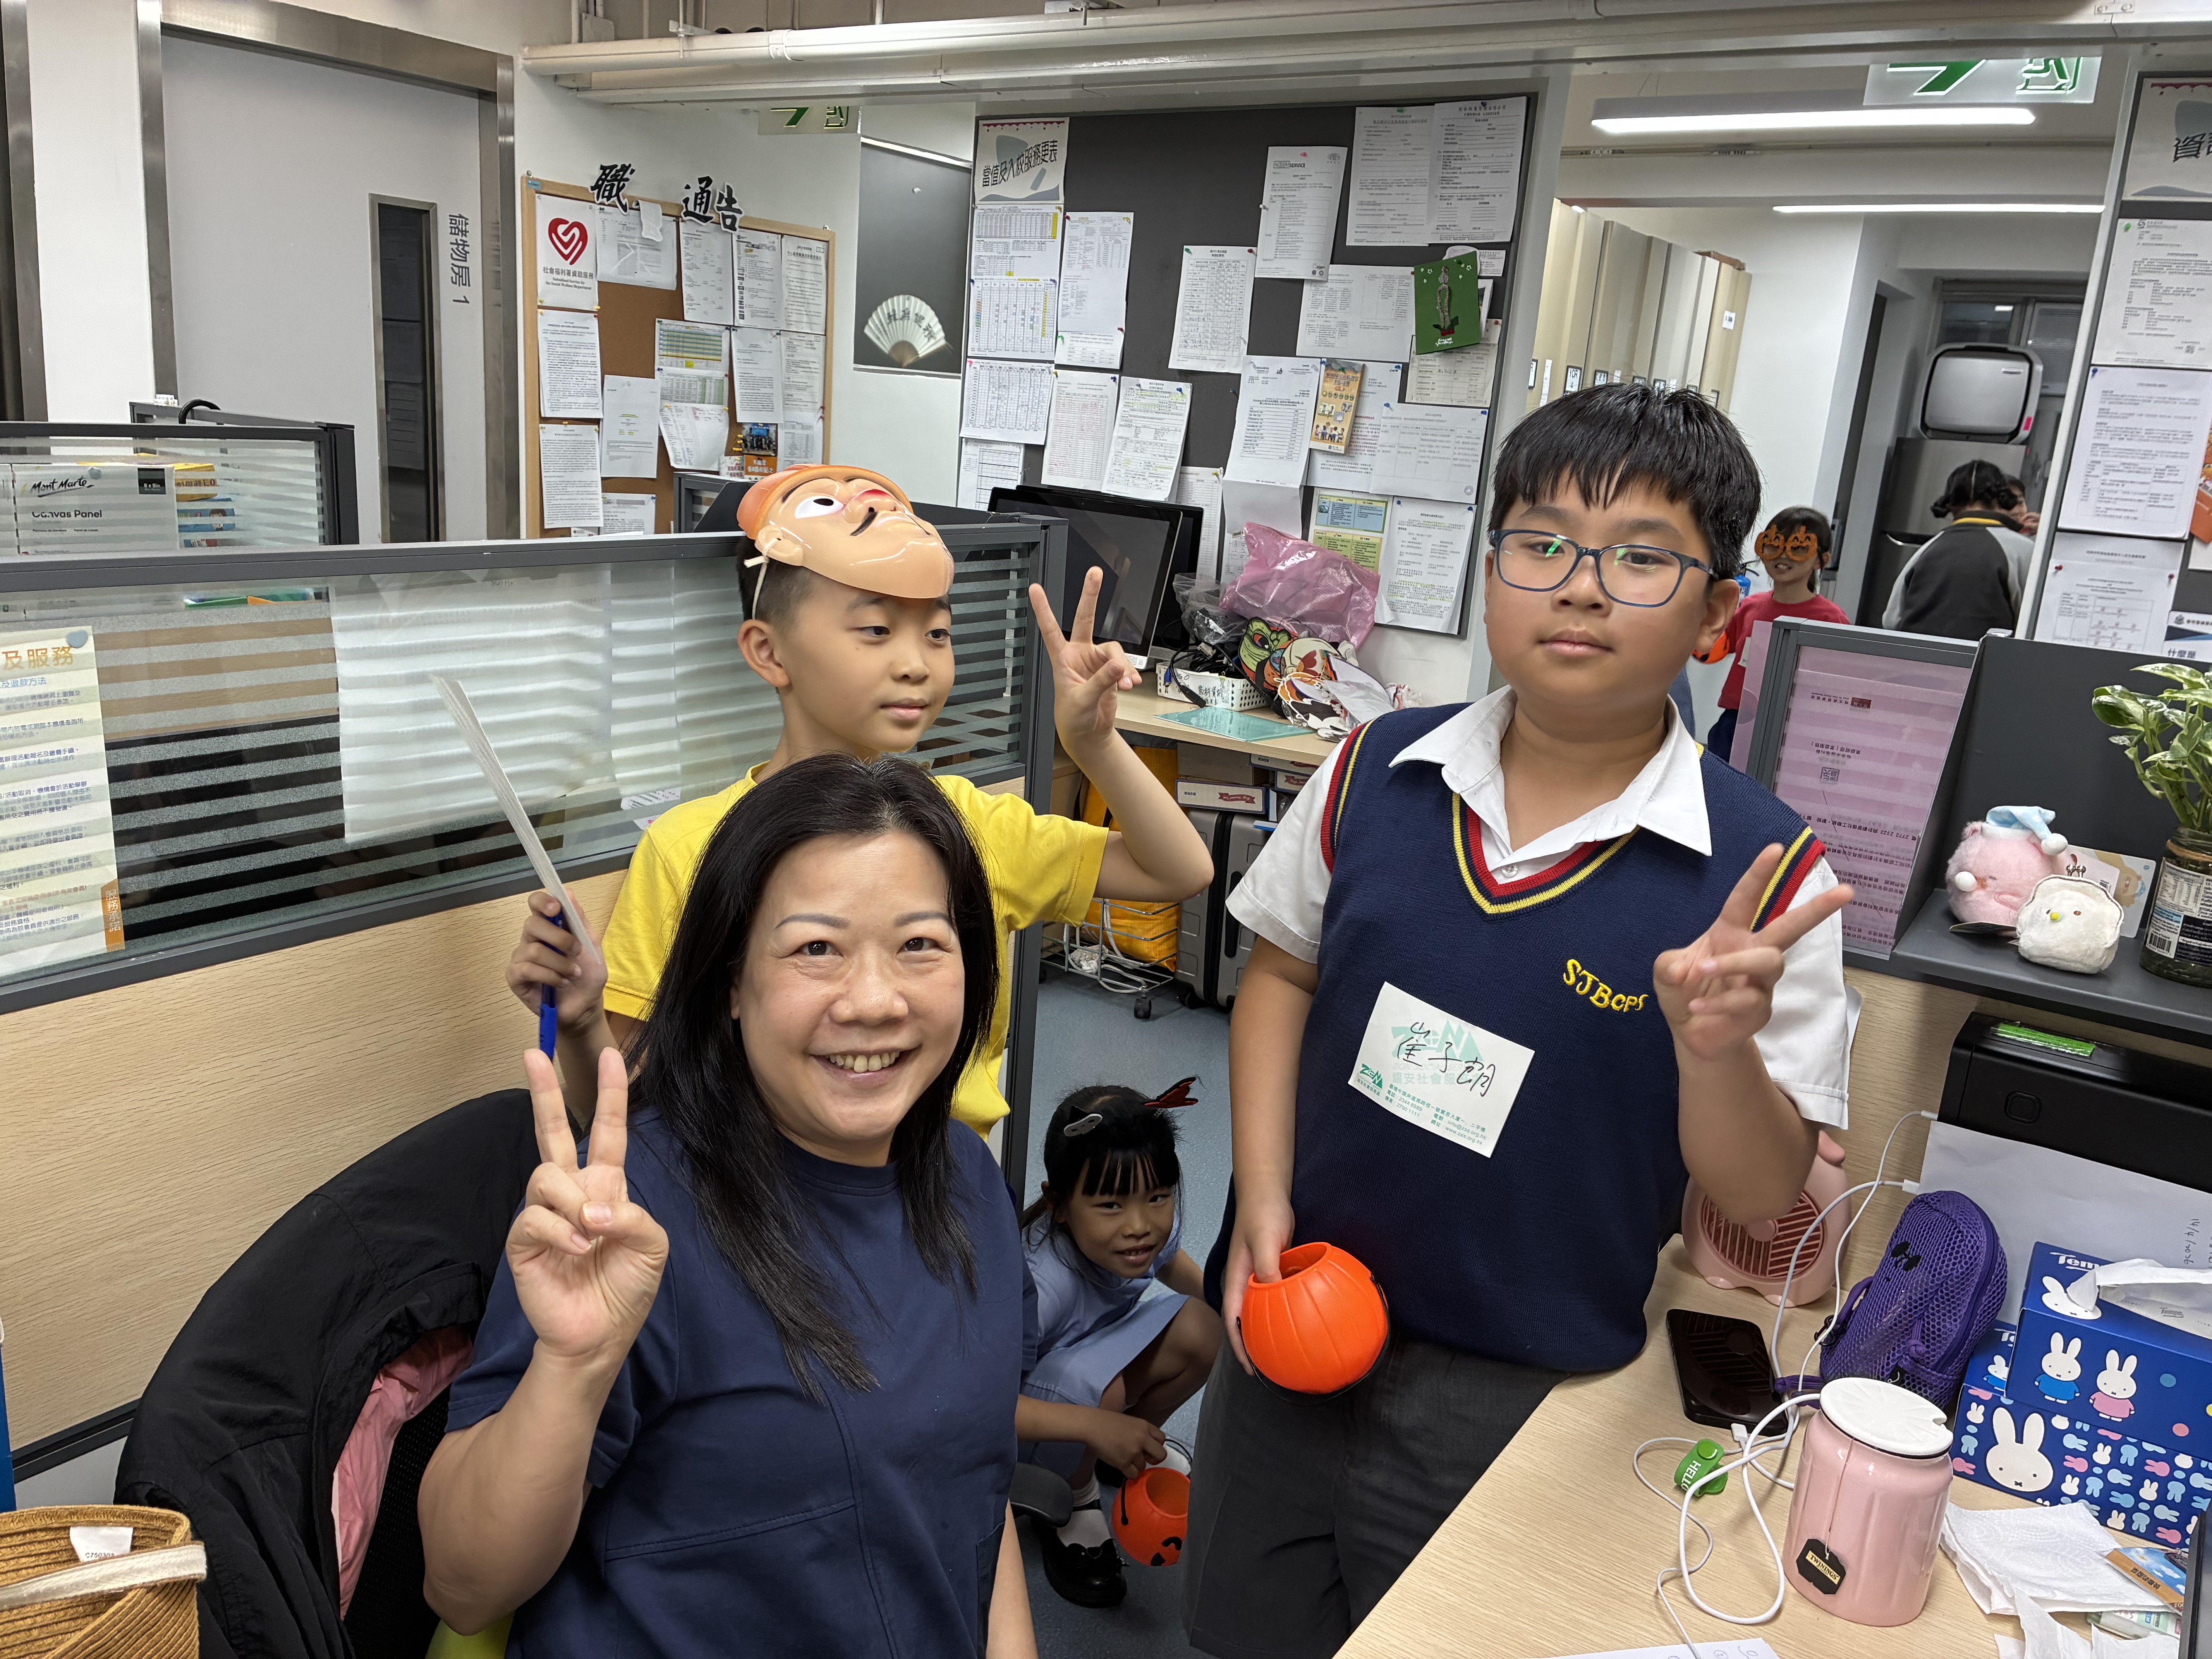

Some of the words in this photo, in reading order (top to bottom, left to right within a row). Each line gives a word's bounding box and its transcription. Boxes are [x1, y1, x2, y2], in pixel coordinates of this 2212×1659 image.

[2172, 132, 2212, 163] 資
[590, 163, 635, 213] 職
[682, 176, 743, 232] 通告
[449, 214, 471, 287] 儲物房
[31, 478, 58, 493] Mont
[58, 476, 87, 489] Marte
[74, 510, 102, 518] Panel
[2, 646, 74, 670] 及服務
[0, 677, 46, 689] 及退款方法
[106, 889, 121, 932] 服務承諾
[2050, 1252, 2100, 1269] Tem
[1680, 1460, 1701, 1491] HELLO
[1810, 1554, 1839, 1580] TWININGS
